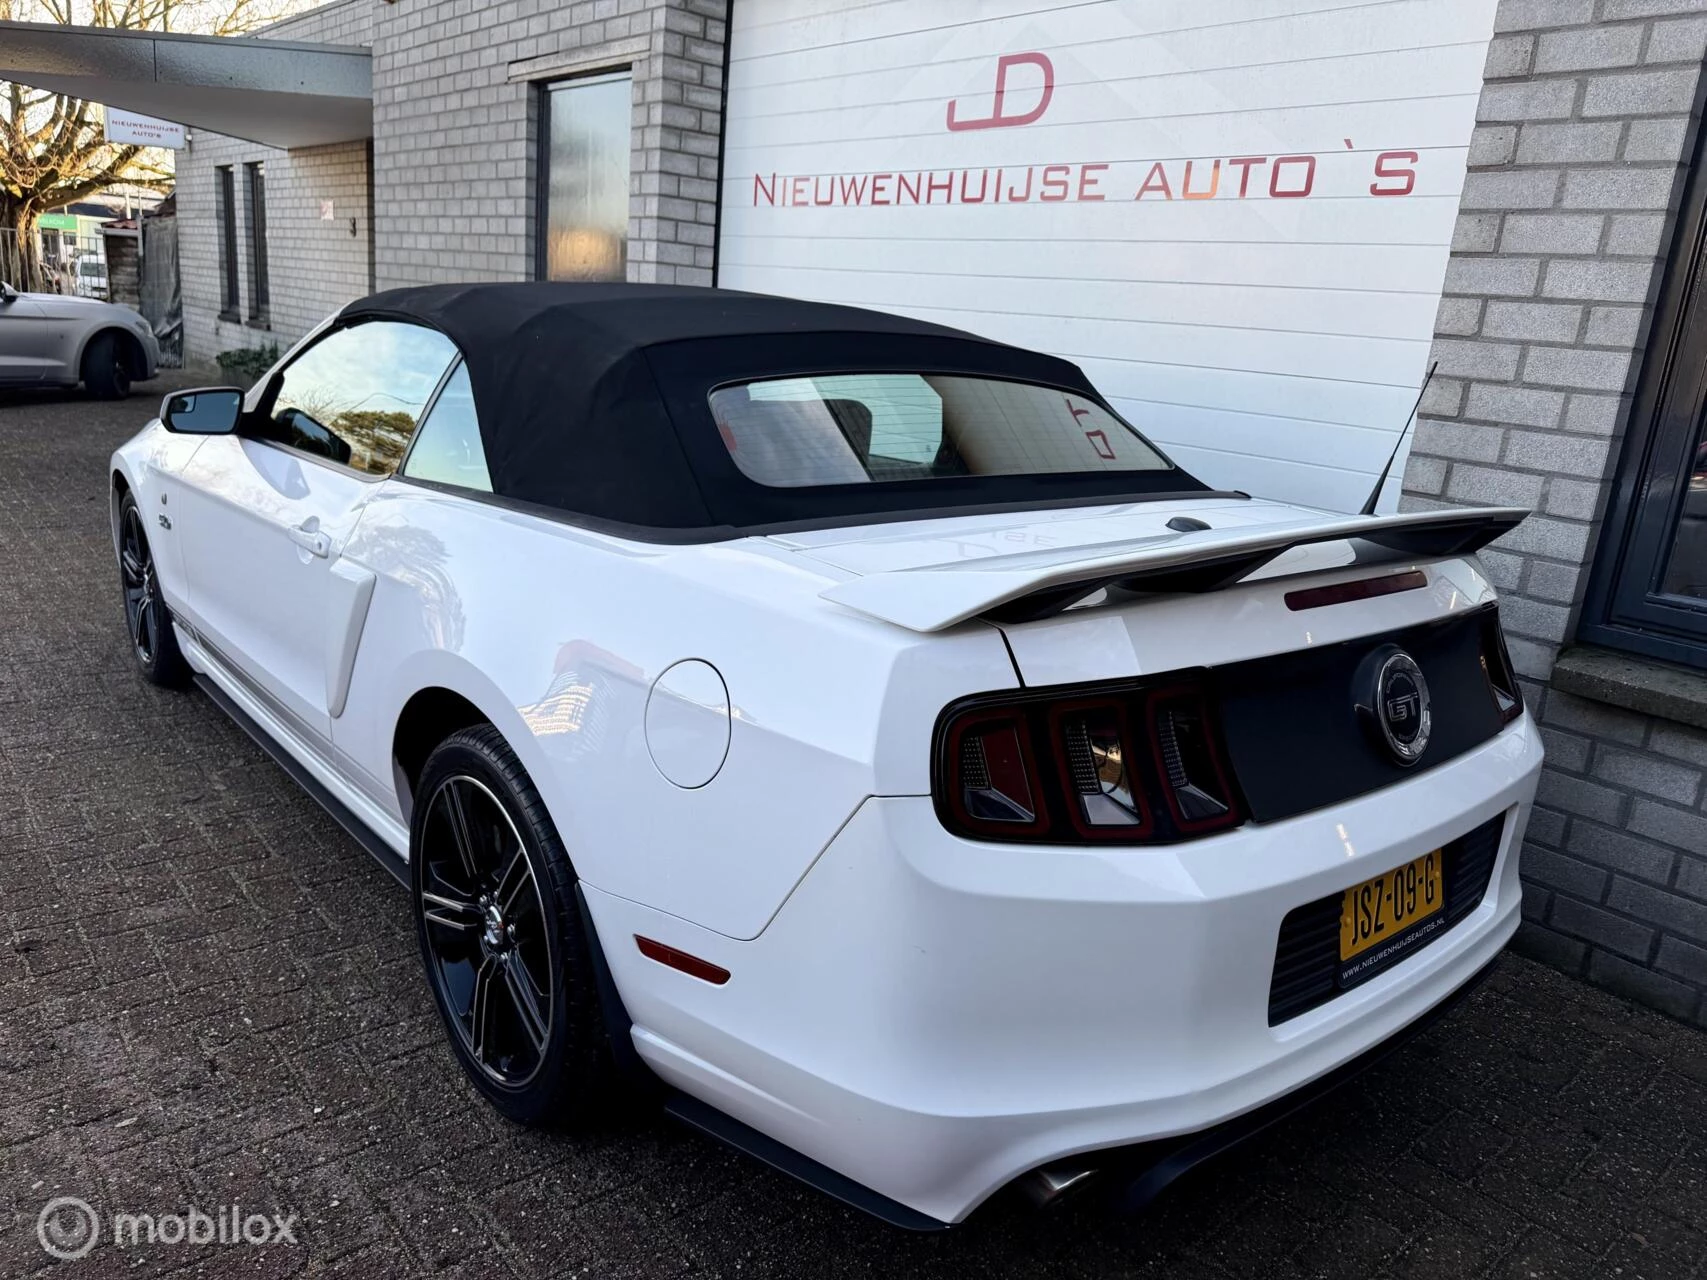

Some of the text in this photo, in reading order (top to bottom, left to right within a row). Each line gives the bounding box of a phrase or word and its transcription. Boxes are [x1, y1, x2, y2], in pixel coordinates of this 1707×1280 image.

[753, 164, 1109, 207] NIEUWENHUIJSE
[1387, 691, 1419, 722] GT
[1351, 853, 1435, 946] JSZ-09-G
[1341, 917, 1446, 980] WWW.NIEUWENHUIJSEAUTOS.NL
